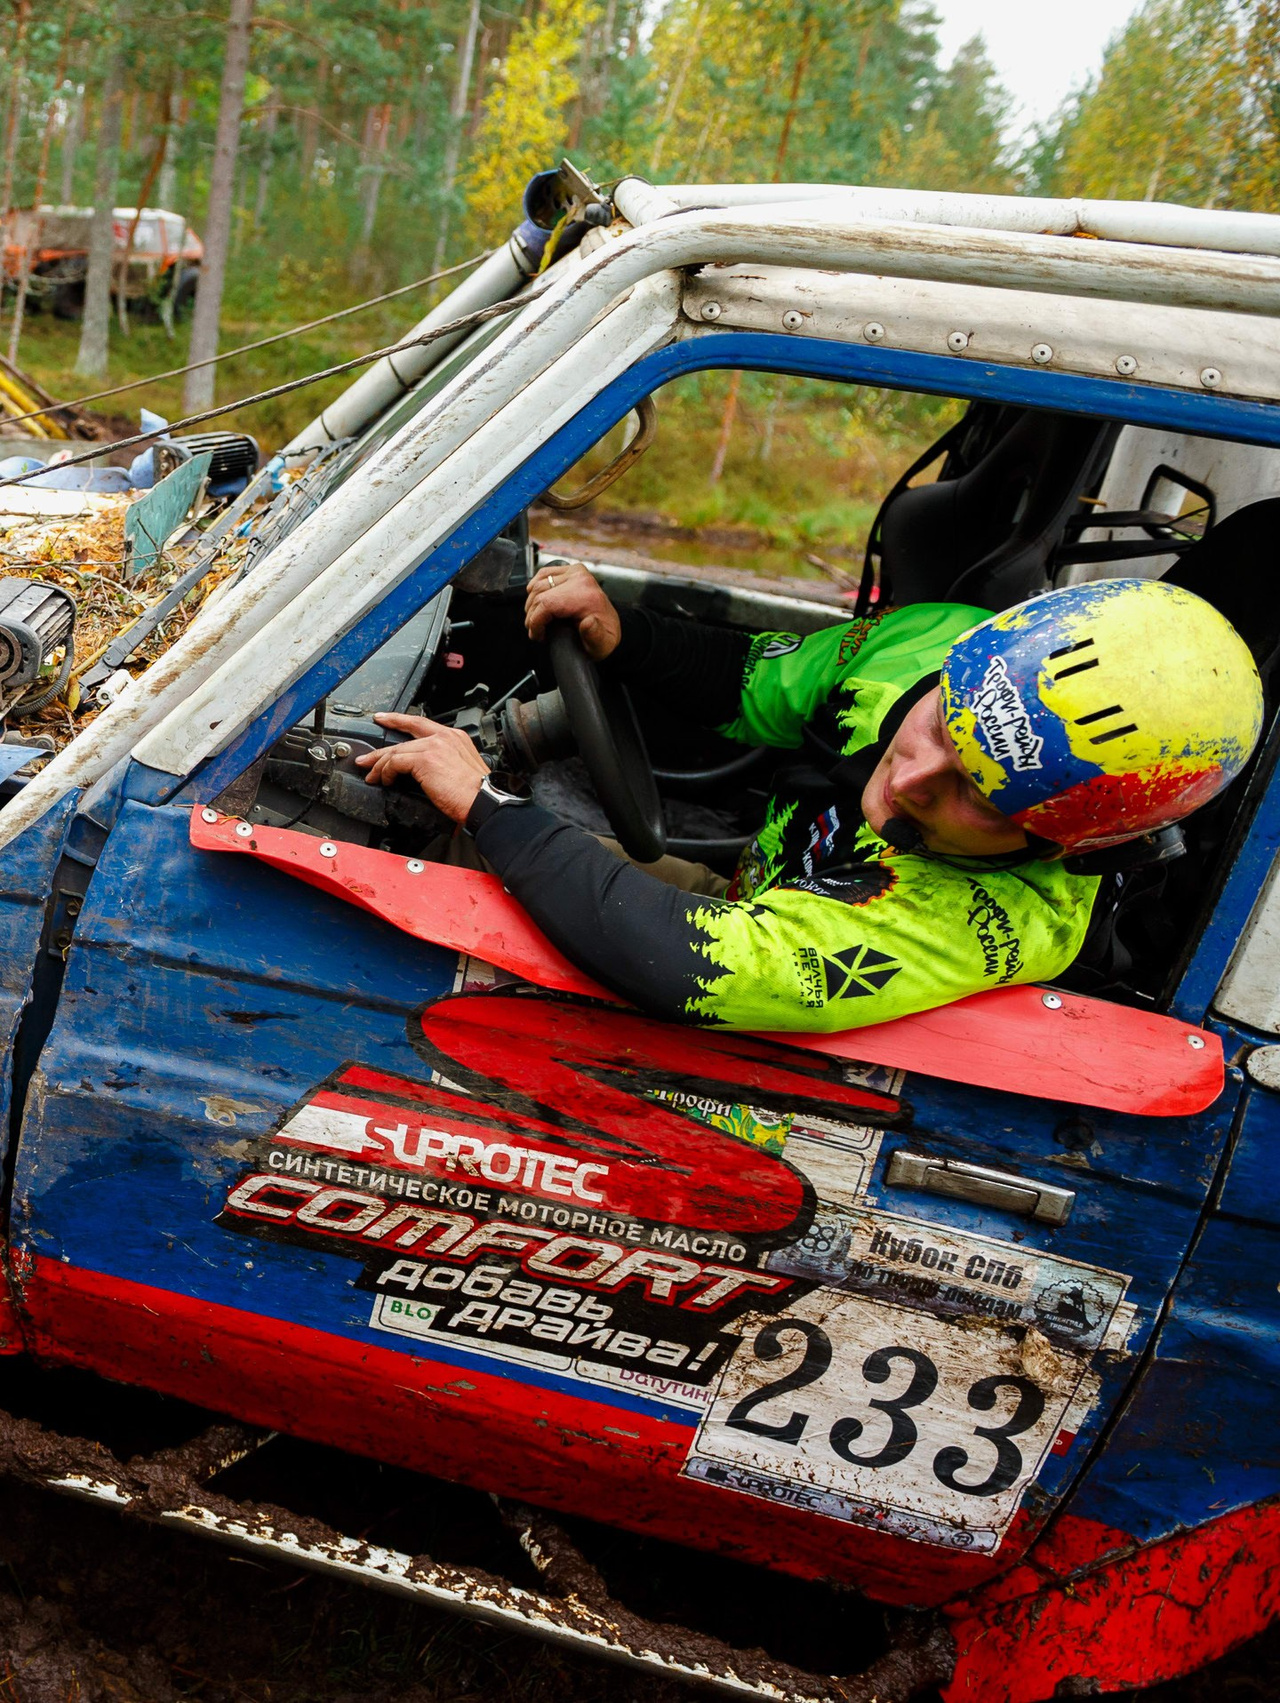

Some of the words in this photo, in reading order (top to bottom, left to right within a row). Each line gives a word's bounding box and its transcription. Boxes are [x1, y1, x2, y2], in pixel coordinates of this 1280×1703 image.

[974, 688, 1010, 758] России
[967, 905, 999, 977] России
[798, 947, 815, 1008] ПЕТЛЯ
[808, 947, 824, 1008] ВОЛЧЬЯ
[362, 1117, 609, 1203] SUPROTEC
[228, 1174, 779, 1307] COMFORT
[267, 1150, 491, 1211] СИНТЕТИЧЕСКОЕ
[495, 1196, 644, 1243] МОТОРНОЕ
[649, 1228, 747, 1263] МАСЛО
[870, 1229, 959, 1276] Кубок
[390, 1300, 438, 1321] BLO
[724, 1318, 1045, 1498] 233
